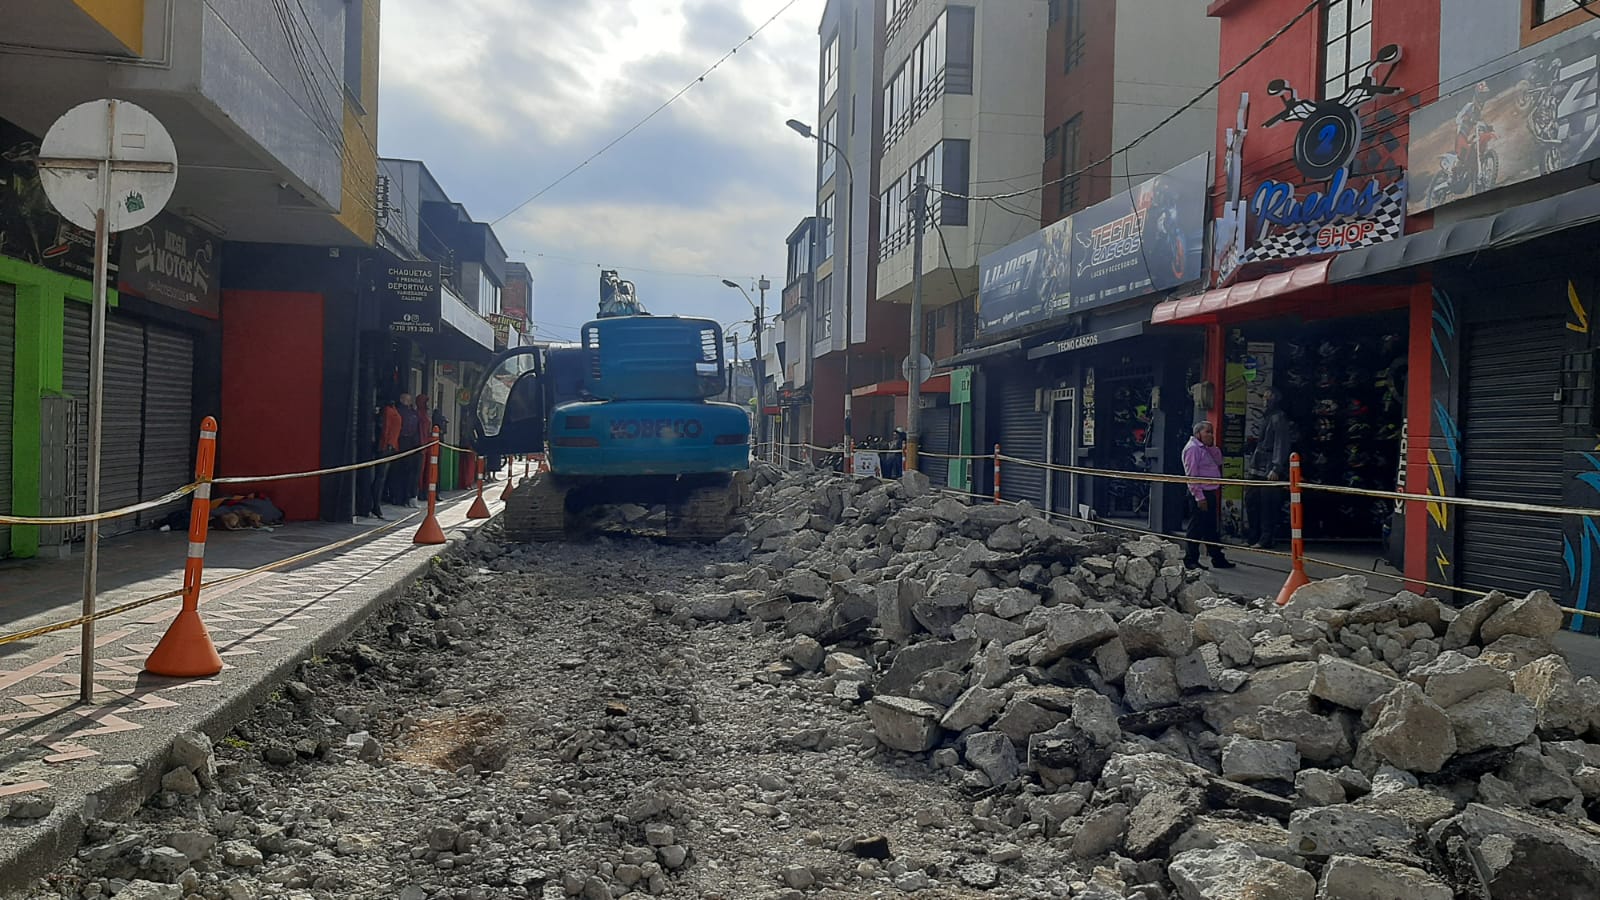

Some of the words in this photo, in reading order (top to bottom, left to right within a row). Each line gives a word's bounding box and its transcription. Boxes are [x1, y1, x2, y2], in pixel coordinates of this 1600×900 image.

[1314, 122, 1338, 156] 2
[1251, 167, 1386, 241] Ruedas
[165, 229, 187, 257] MEGA
[1091, 208, 1147, 249] TECNO
[1318, 222, 1376, 248] SHOP
[1092, 234, 1142, 265] CASCOS
[156, 247, 193, 284] MOTOS
[388, 267, 433, 278] CHAQUETAS
[387, 282, 434, 292] DEPORTIVAS
[1057, 340, 1075, 353] TECNO
[1075, 335, 1097, 349] CASCOS
